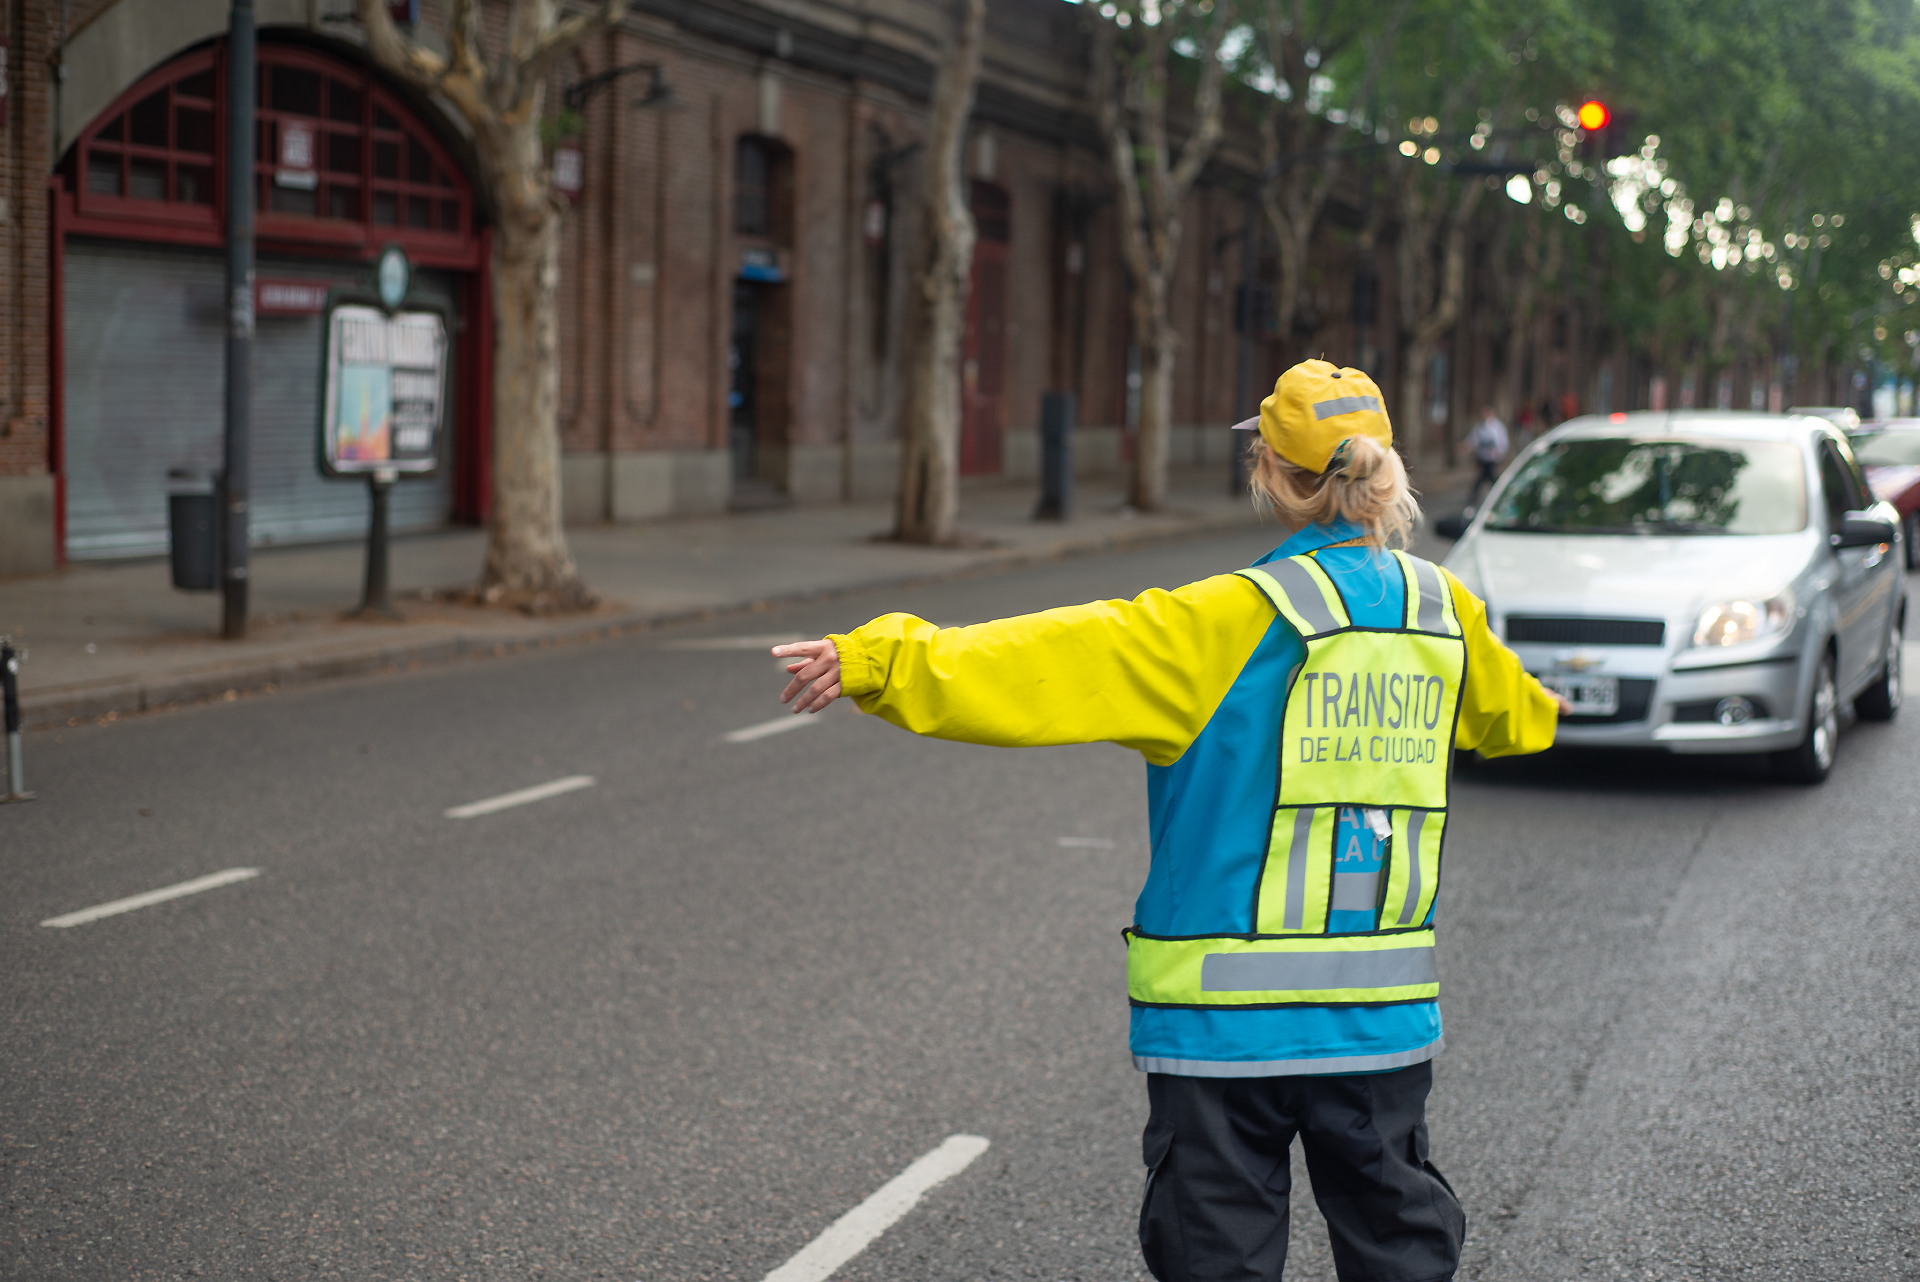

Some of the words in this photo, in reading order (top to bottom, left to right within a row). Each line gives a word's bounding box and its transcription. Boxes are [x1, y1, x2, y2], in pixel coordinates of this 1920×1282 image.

[1304, 672, 1444, 730] TRANSITO
[1300, 737, 1330, 763] DE
[1334, 736, 1362, 762] LA
[1370, 735, 1436, 764] CIUDAD
